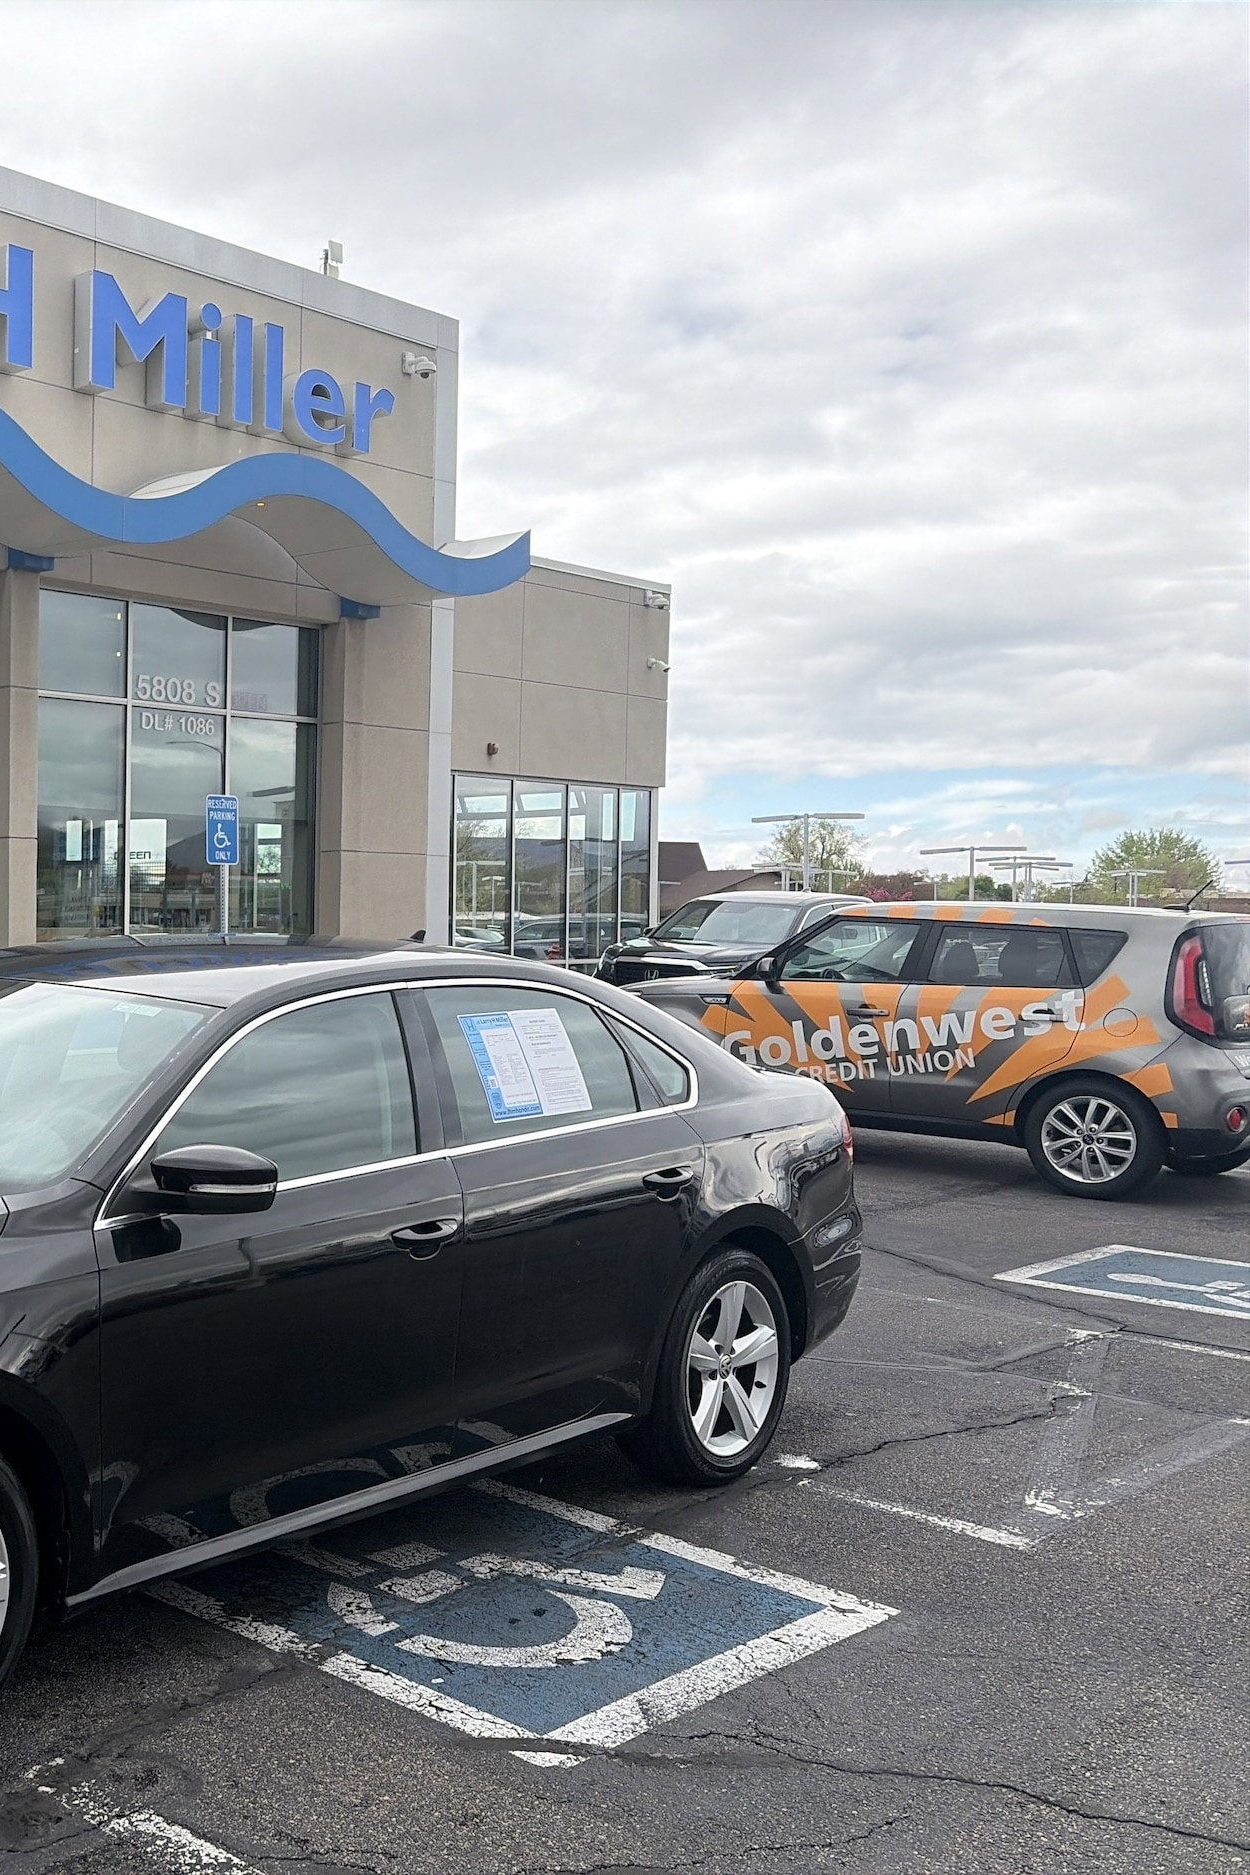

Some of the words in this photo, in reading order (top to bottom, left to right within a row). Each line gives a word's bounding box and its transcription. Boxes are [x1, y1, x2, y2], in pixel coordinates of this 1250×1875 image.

[74, 269, 395, 456] Miller
[137, 674, 196, 704] 5808
[205, 682, 220, 707] S
[142, 711, 173, 731] DL#
[178, 716, 215, 736] 1086
[208, 799, 237, 810] RESERVED
[209, 810, 236, 821] PARKING
[215, 850, 231, 861] ONLY
[722, 991, 1087, 1066] Goldenwest
[886, 1047, 976, 1077] UNION
